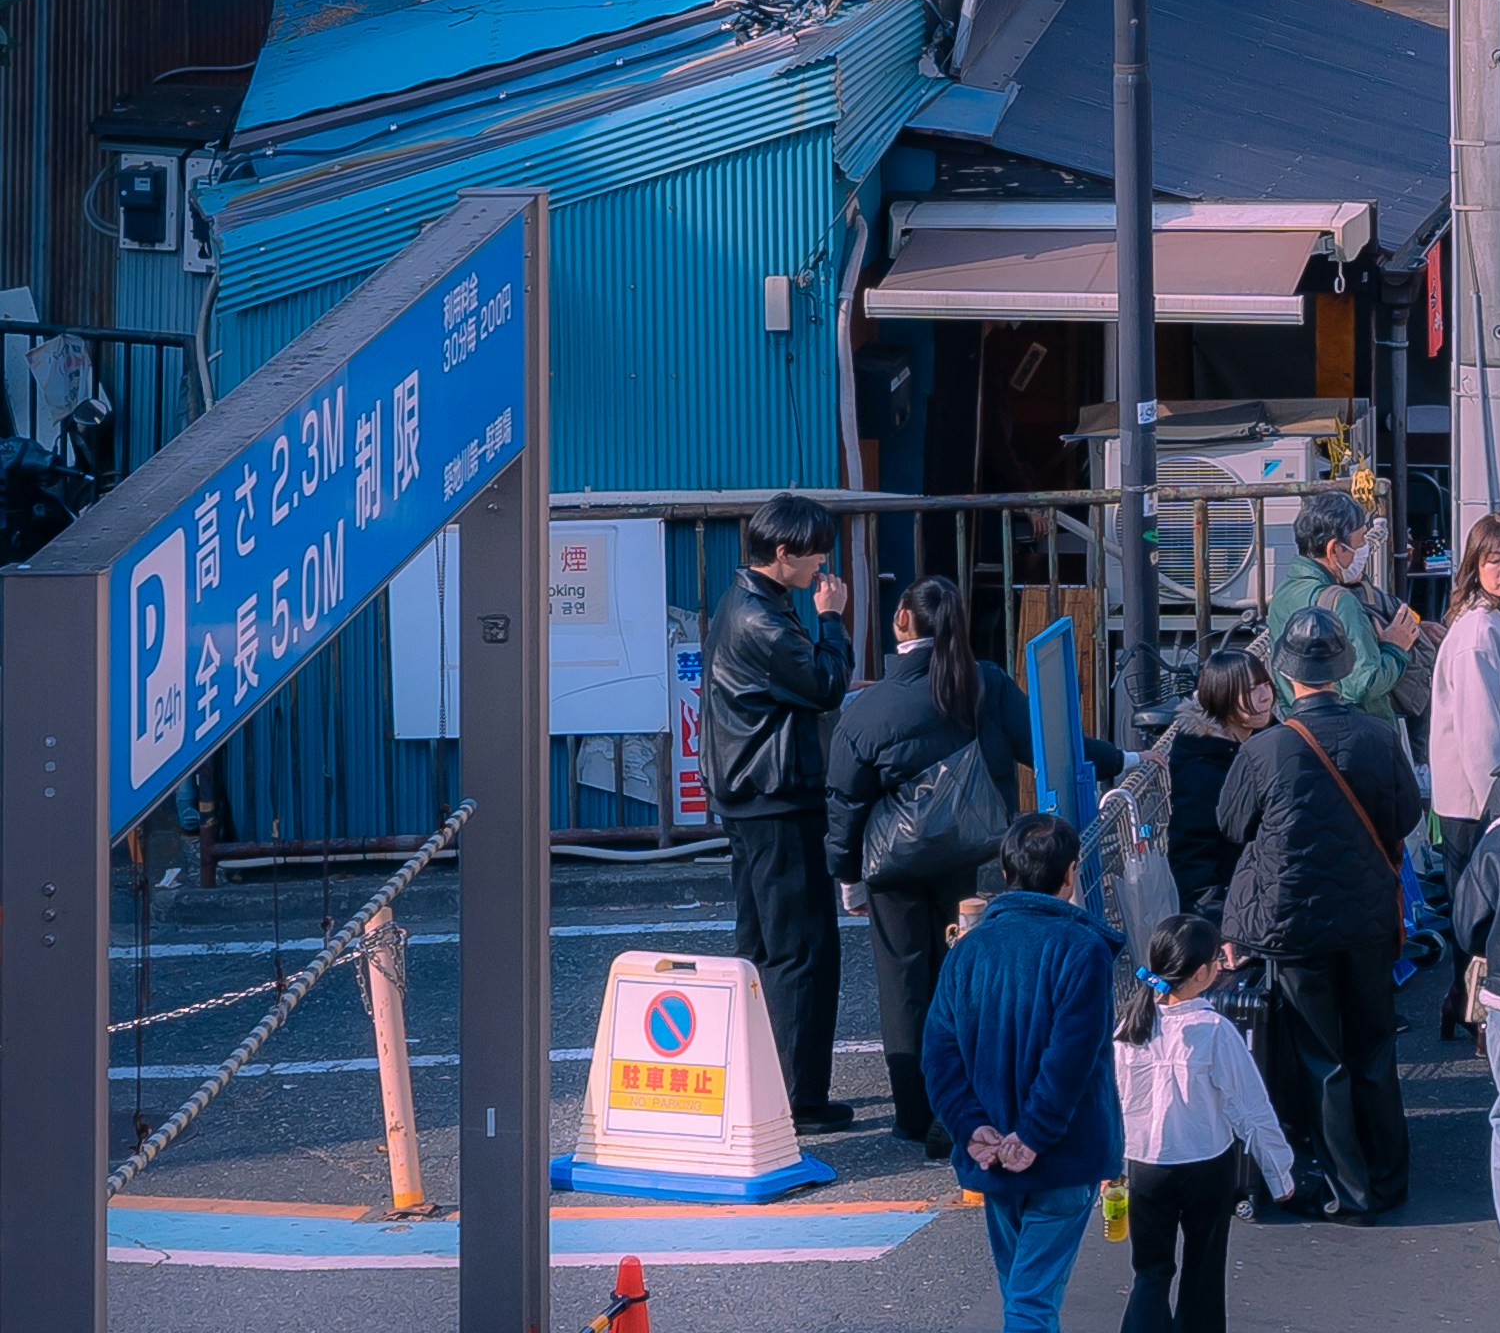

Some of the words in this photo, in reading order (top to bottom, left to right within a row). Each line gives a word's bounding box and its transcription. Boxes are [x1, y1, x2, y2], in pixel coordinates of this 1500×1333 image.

[479, 282, 512, 341] 200円
[195, 463, 258, 604] 高さ
[271, 384, 345, 528] 2.3M
[354, 368, 420, 531] 制限
[136, 572, 166, 742] P
[194, 594, 259, 742] 全長
[271, 518, 345, 661] 5.0M
[152, 681, 182, 745] 24h
[620, 1064, 713, 1094] 駐車禁止
[630, 1096, 647, 1108] NO
[652, 1096, 703, 1112] PARKING
